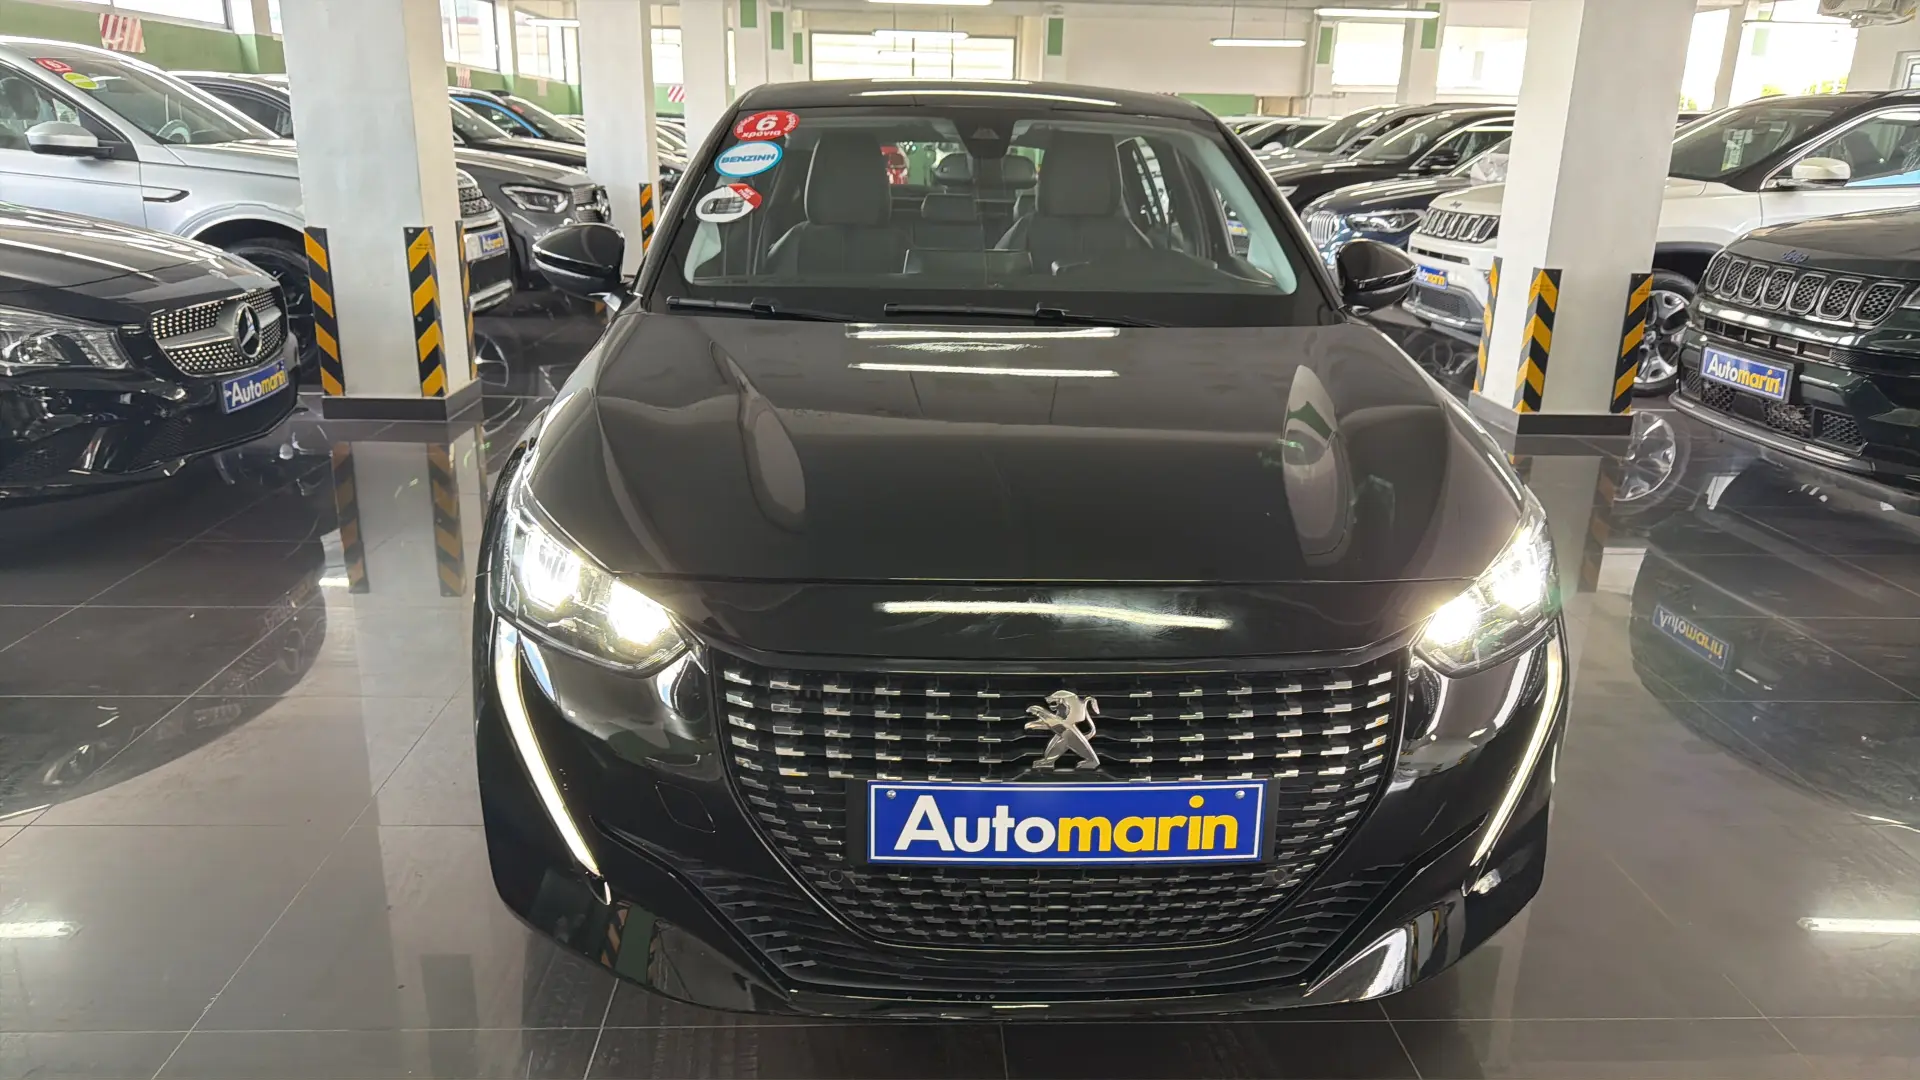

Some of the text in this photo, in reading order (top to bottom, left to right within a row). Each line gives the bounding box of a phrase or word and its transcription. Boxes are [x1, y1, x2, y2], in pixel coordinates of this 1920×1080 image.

[756, 116, 778, 131] 6
[231, 364, 286, 407] Automarin
[1706, 353, 1781, 394] Automarin
[893, 795, 1239, 854] Automarin
